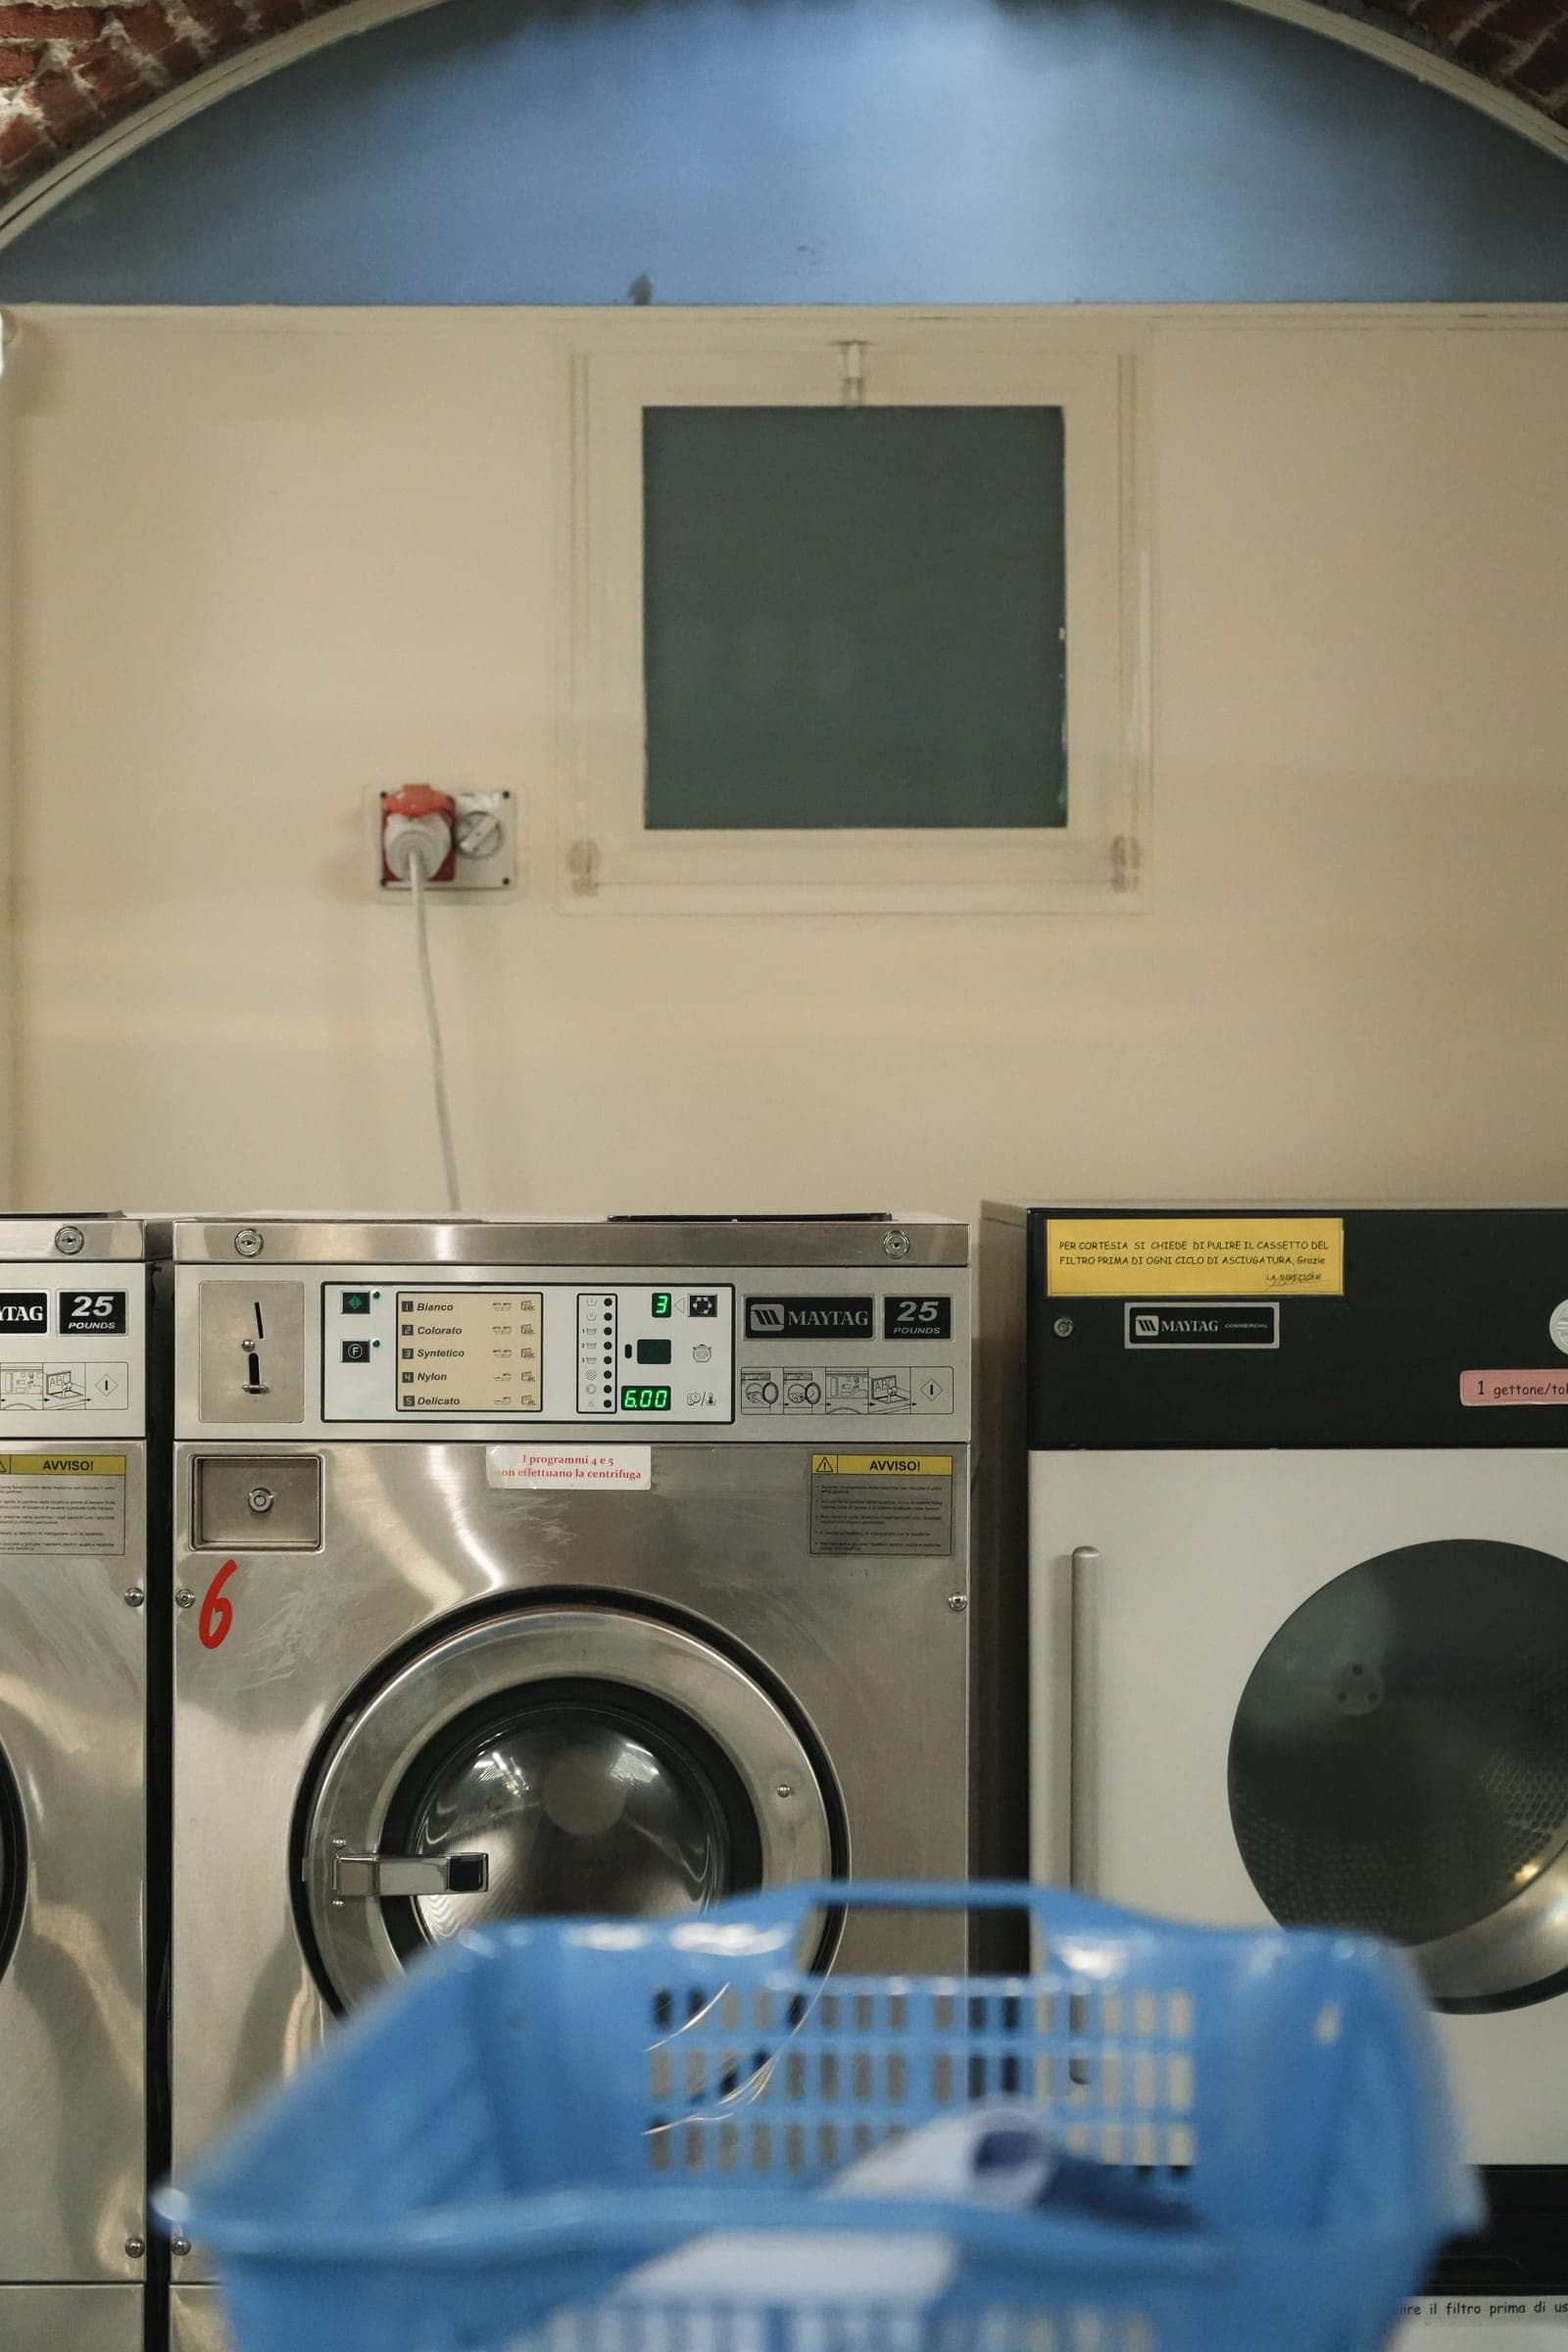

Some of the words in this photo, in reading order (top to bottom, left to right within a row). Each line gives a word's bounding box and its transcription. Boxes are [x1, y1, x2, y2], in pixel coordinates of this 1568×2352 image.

[1058, 1241, 1076, 1250] PER
[1079, 1241, 1128, 1250] CORTESIA
[1134, 1241, 1146, 1250] SI
[1151, 1241, 1188, 1250] CHIEDE
[1193, 1241, 1205, 1250] DI
[1207, 1241, 1241, 1250] PULIRE
[1245, 1241, 1254, 1250] IL
[1256, 1241, 1309, 1250] CASSETTO
[1311, 1241, 1329, 1250] DEL
[1059, 1256, 1096, 1265] FILTRO
[1098, 1256, 1129, 1265] PRIMA
[1132, 1256, 1144, 1265] DI
[1146, 1256, 1172, 1265] OGNI
[1175, 1256, 1204, 1265] CICLO
[1206, 1256, 1218, 1265] DI
[1297, 1256, 1325, 1265] Grazie
[72, 1296, 114, 1317] 25
[416, 1302, 454, 1311] Bianco
[656, 1296, 668, 1314] 3
[897, 1301, 939, 1322] 25
[788, 1311, 868, 1325] MAYTAG
[1161, 1320, 1218, 1332] MAYTAG
[416, 1349, 465, 1359] Syntetico
[417, 1372, 447, 1382] Nylon
[1478, 1380, 1484, 1396] 1
[1494, 1383, 1568, 1398] gettone/to
[417, 1396, 460, 1405] Delicato
[624, 1390, 667, 1408] 6.00
[42, 1459, 94, 1471] AVVISO!
[529, 1455, 588, 1466] programmi
[869, 1460, 920, 1471] AVVISO!
[518, 1468, 572, 1478] effettuano
[575, 1469, 584, 1478] la
[587, 1469, 641, 1481] centrifuga
[199, 1558, 238, 1649] 6
[1430, 2303, 1437, 2315] il
[1446, 2302, 1481, 2315] filtro
[1490, 2303, 1526, 2317] prima
[1534, 2301, 1545, 2313] di
